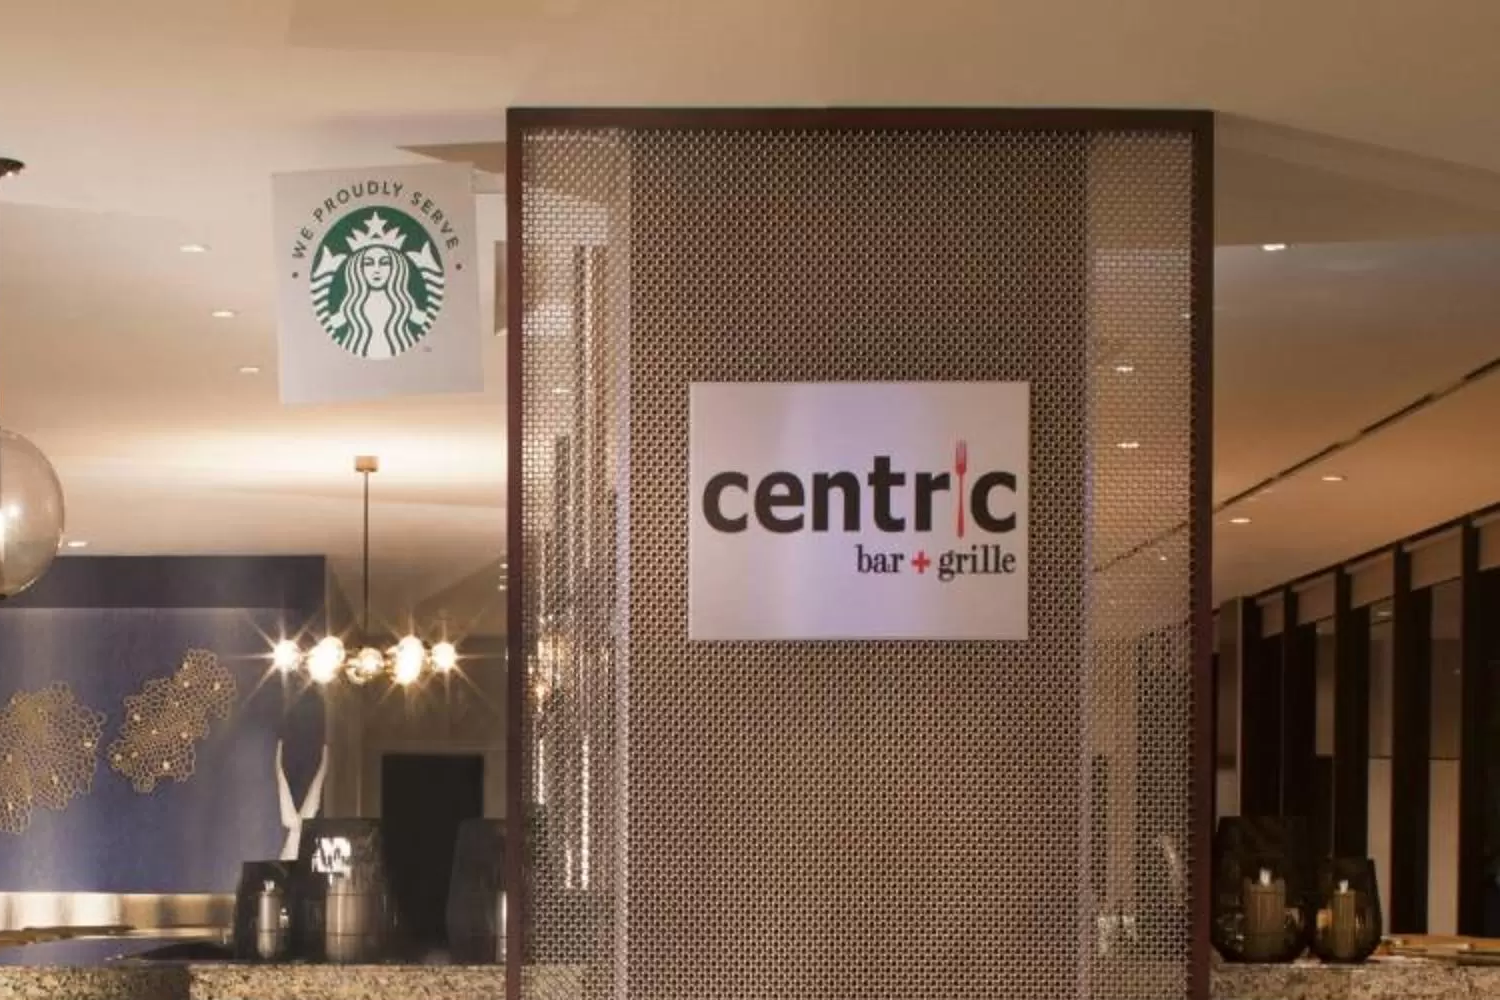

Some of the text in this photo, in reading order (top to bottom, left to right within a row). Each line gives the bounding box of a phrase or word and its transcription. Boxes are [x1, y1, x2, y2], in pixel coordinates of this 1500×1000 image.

[292, 180, 460, 259] WE PROUDLY SERVE
[702, 440, 1017, 538] centric
